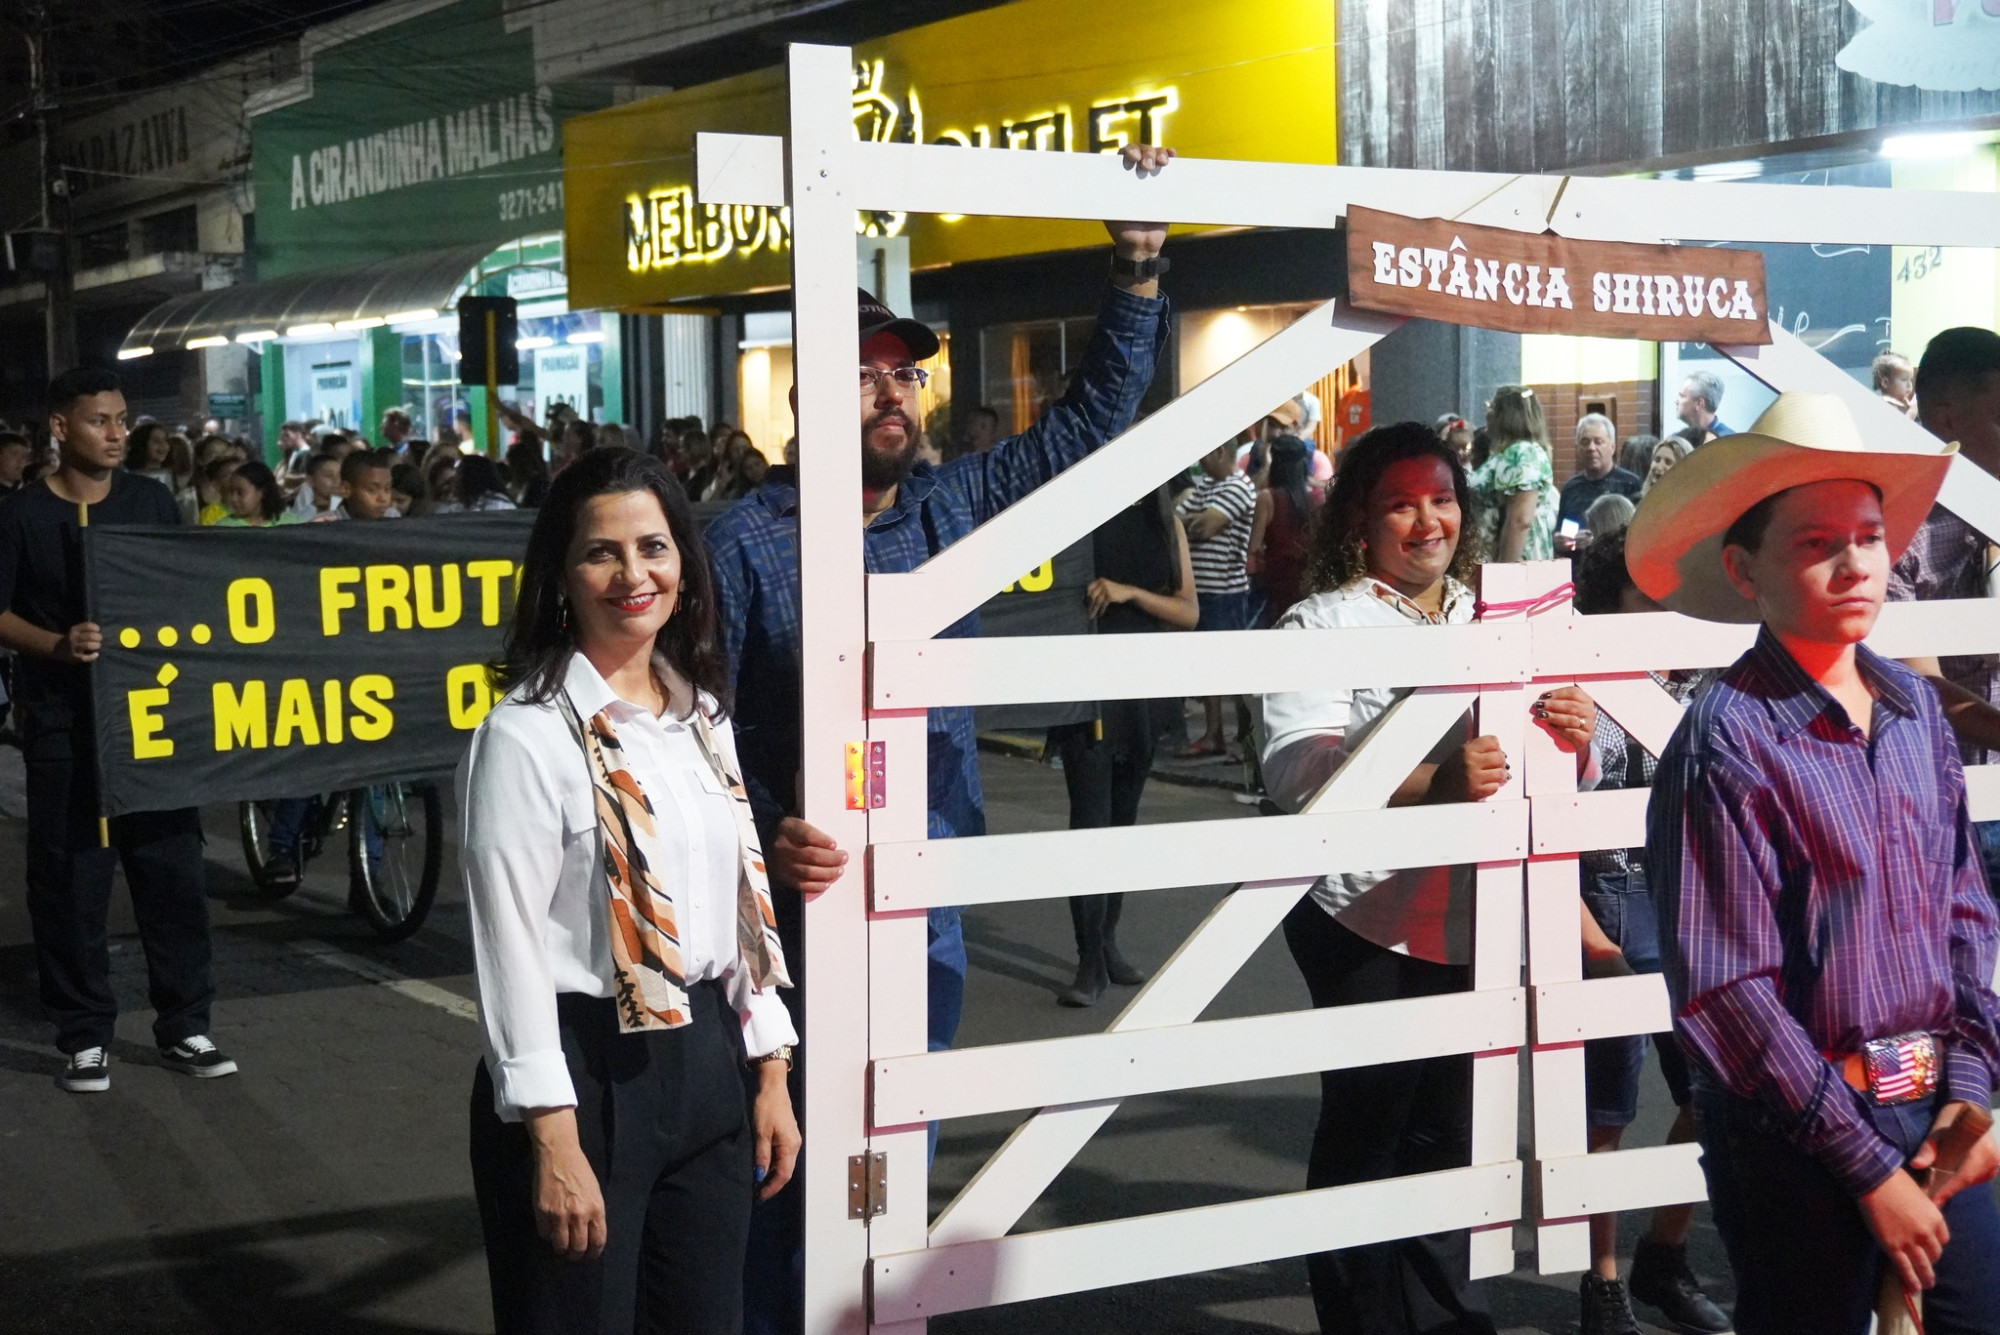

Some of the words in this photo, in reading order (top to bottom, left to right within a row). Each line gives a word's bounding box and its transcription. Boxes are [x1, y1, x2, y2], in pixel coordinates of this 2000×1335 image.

[291, 154, 307, 211] A
[309, 117, 444, 207] CIRANDINHA
[446, 84, 555, 178] MALHAS
[1372, 234, 1573, 310] ESTÂNCIA
[1592, 271, 1758, 321] SHIRUCA
[1896, 244, 1944, 284] 432
[319, 559, 523, 637] FRUT
[127, 662, 179, 760] É
[211, 674, 395, 752] MAIS
